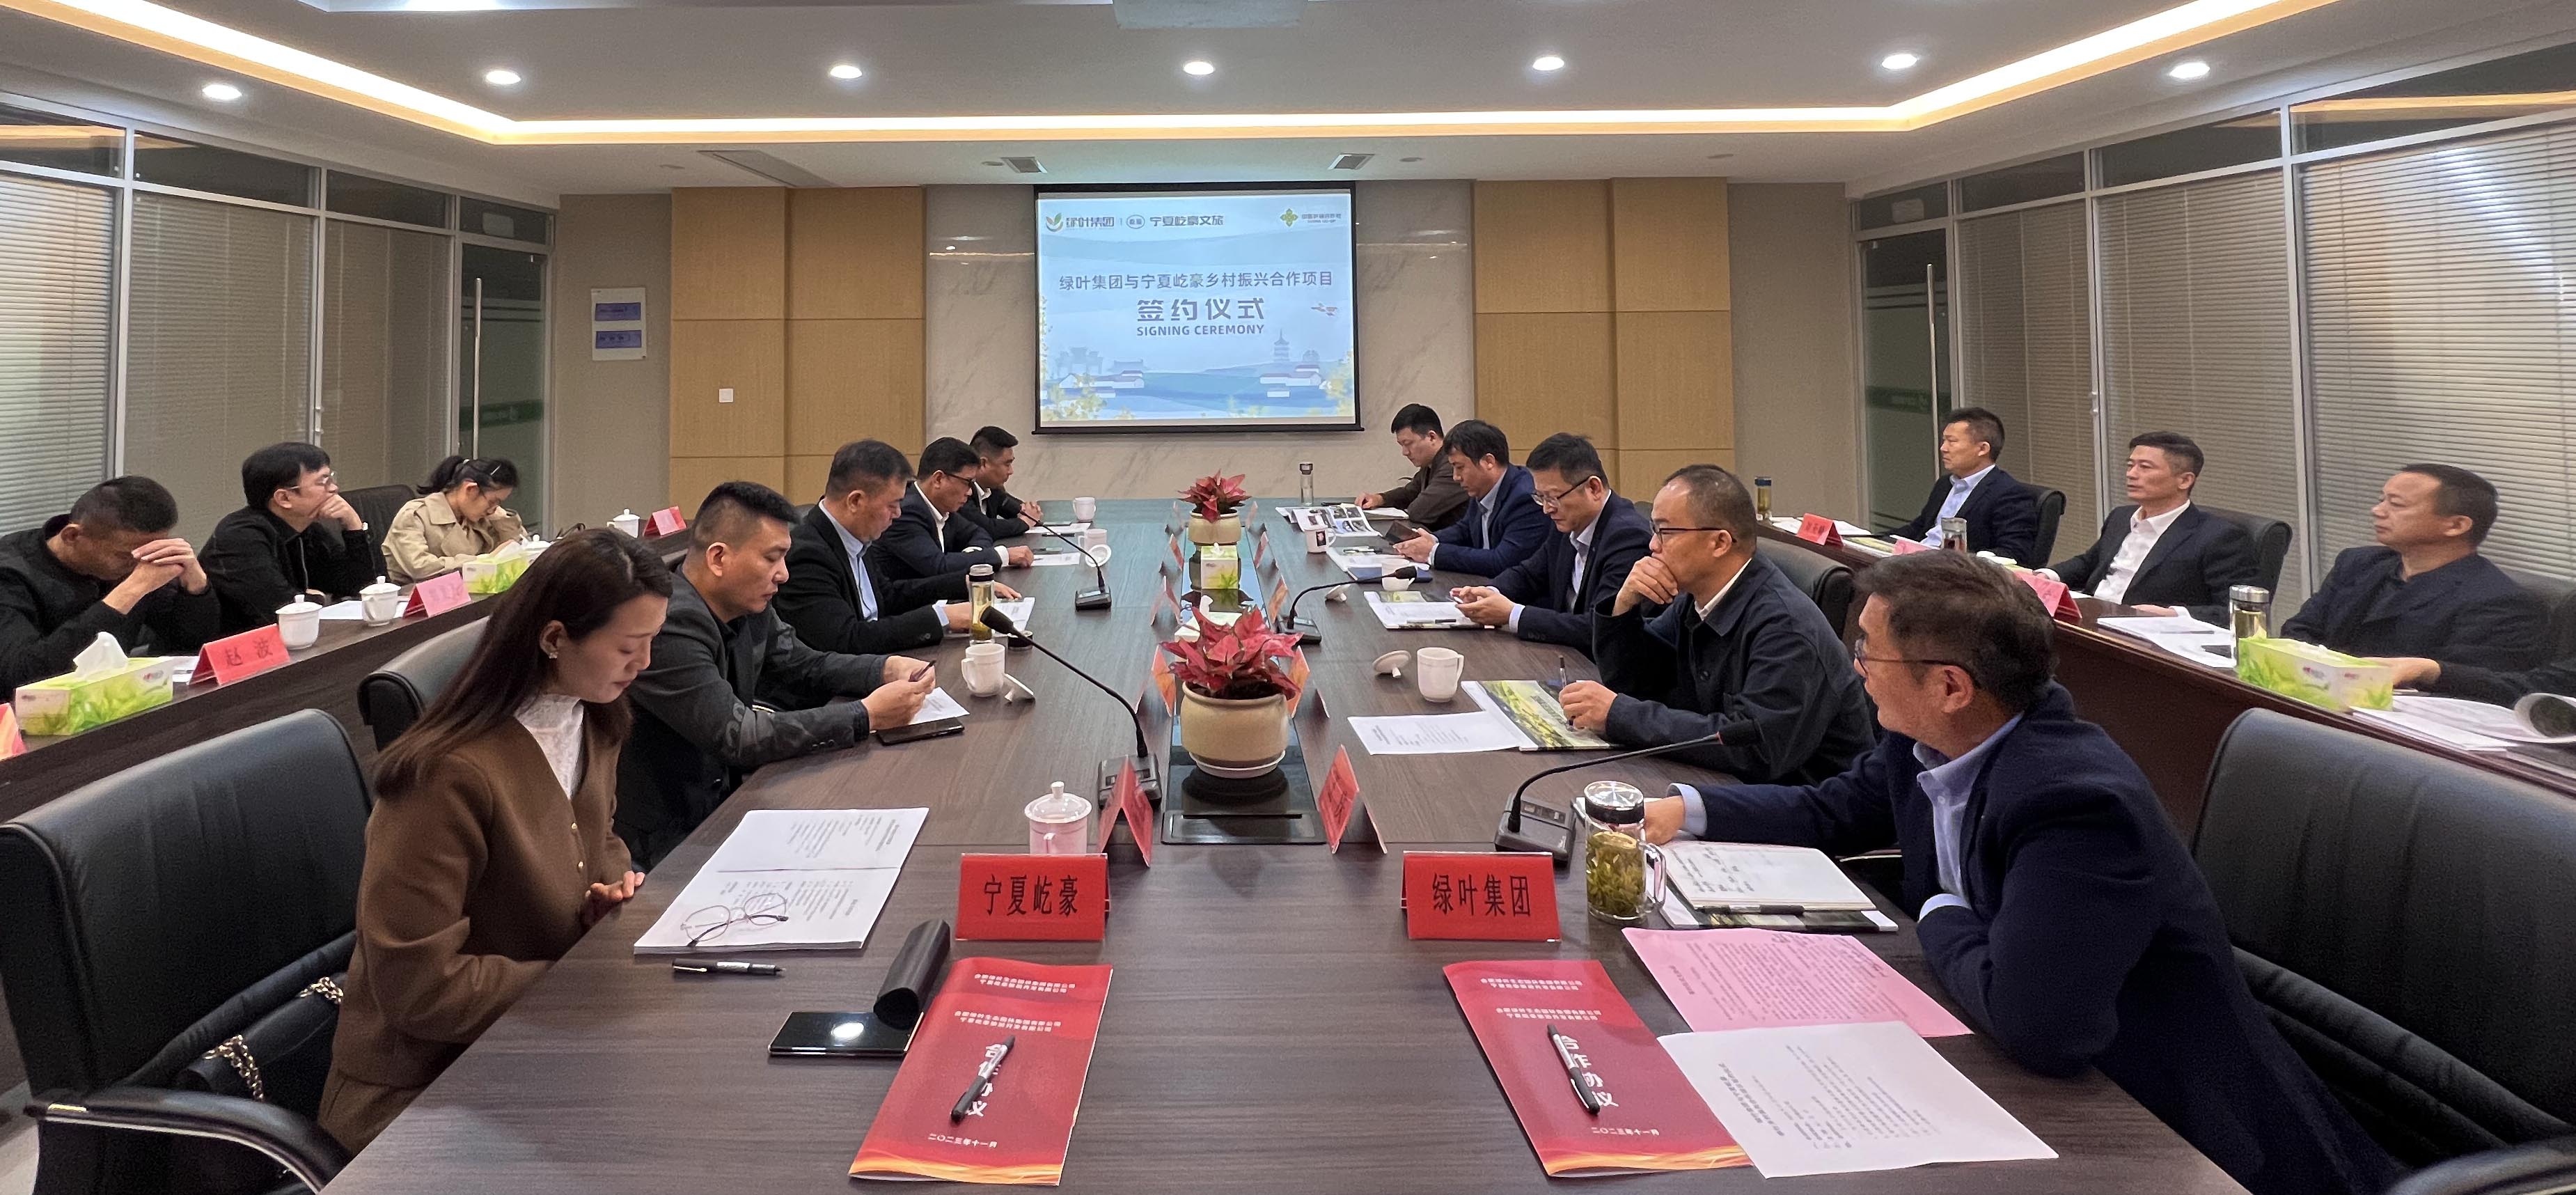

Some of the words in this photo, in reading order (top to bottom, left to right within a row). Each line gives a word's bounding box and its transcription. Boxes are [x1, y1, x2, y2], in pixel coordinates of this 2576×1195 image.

[1149, 214, 1224, 227] 宁夏屹豪文旅
[1058, 271, 1333, 290] 绿叶集团与宁夏屹豪乡村振兴合作项目
[1136, 297, 1264, 322] 签约仪式
[1136, 325, 1191, 336] SIGNING
[1194, 325, 1264, 335] CEREMONY
[984, 873, 1078, 917] 宁夏屹豪
[1432, 872, 1530, 917] 绿叶集团
